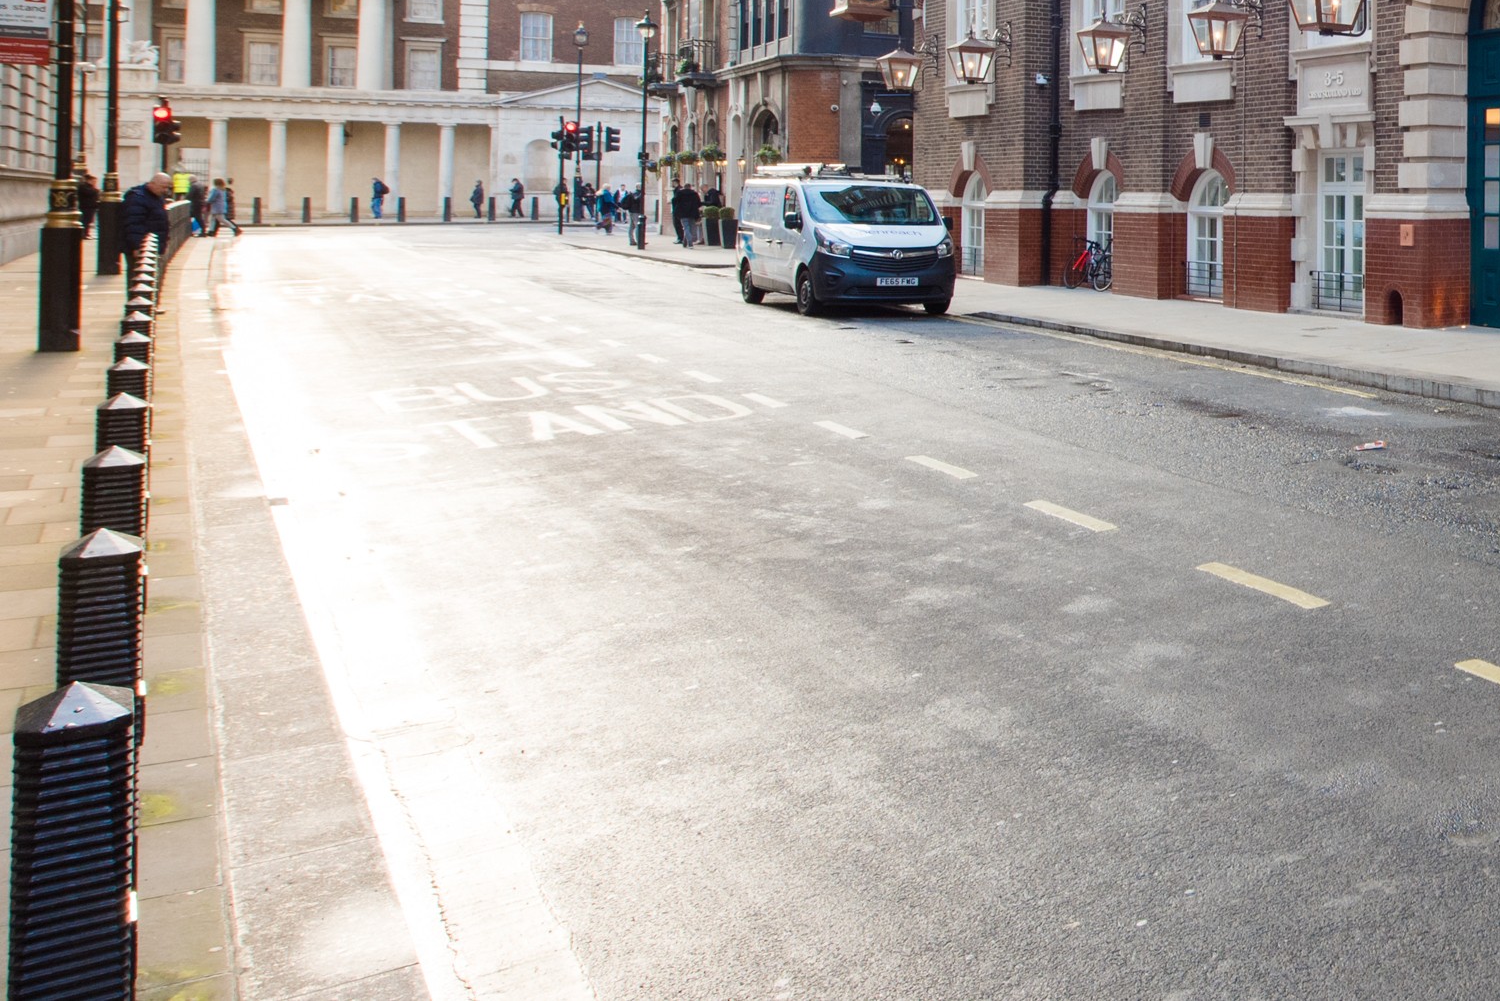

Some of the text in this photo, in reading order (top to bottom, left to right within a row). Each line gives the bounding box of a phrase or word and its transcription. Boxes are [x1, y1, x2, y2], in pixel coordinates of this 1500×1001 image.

[1324, 70, 1344, 87] 3-5
[369, 370, 635, 415] BUS
[331, 394, 754, 462] STAND
